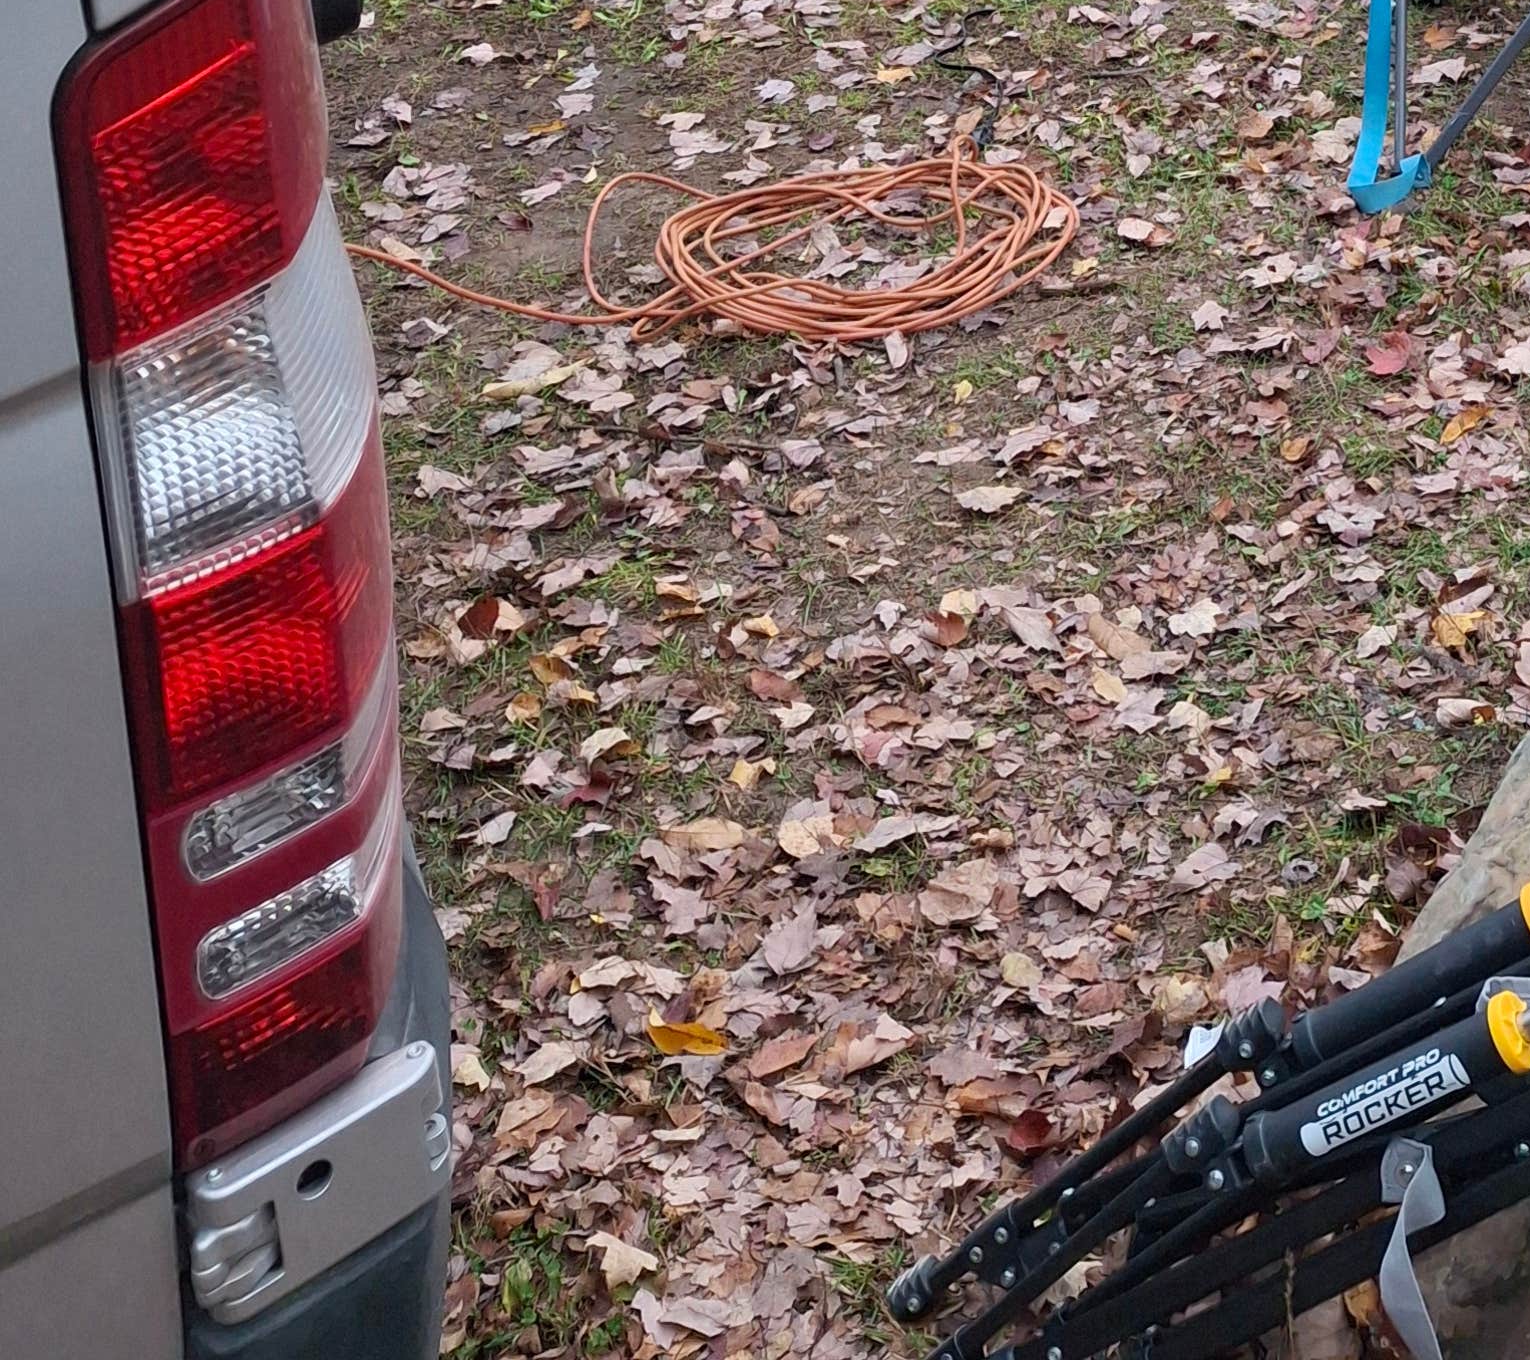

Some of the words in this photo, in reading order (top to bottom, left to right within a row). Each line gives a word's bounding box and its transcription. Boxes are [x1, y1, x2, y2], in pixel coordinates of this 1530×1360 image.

[1316, 1068, 1399, 1118] COMFORT
[1402, 1048, 1441, 1078] PRO
[1321, 1070, 1447, 1146] ROCKER
